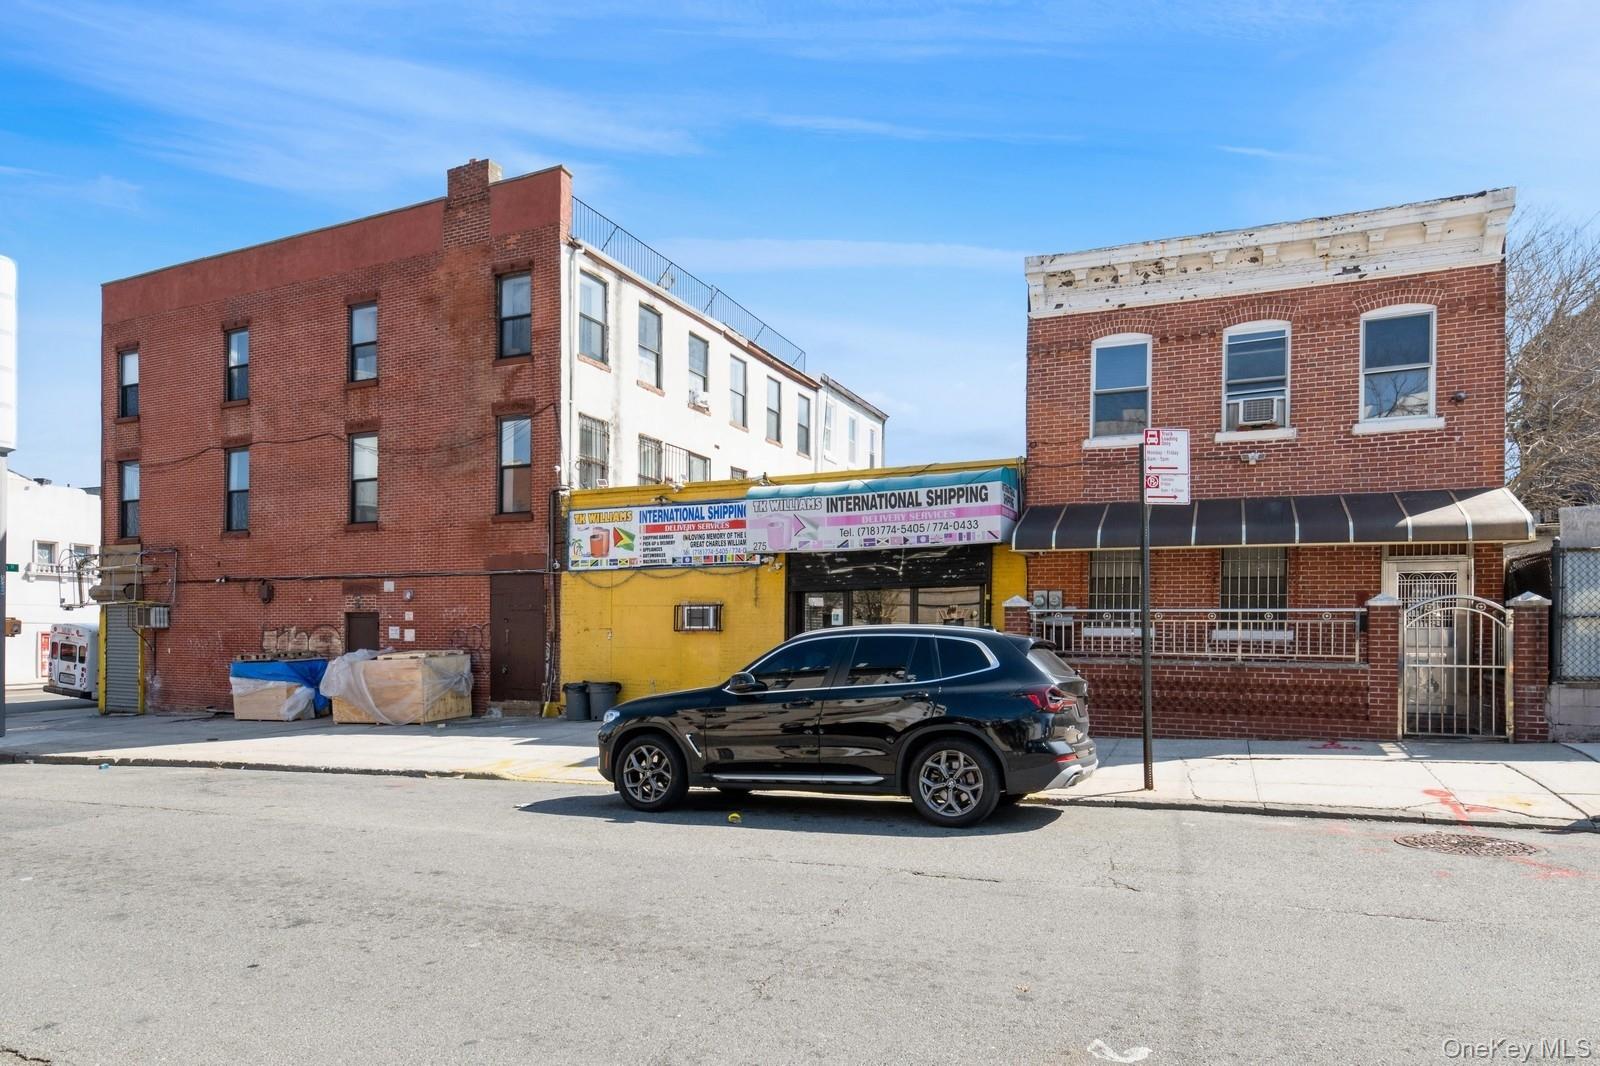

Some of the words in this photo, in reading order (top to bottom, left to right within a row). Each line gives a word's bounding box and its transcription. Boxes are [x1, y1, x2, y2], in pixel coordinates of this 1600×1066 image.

[753, 501, 768, 512] TK
[769, 498, 822, 512] WILLIAMS
[826, 491, 922, 513] INTERNATIONAL
[926, 485, 989, 507] SHIPPING
[574, 514, 586, 524] TK
[588, 511, 632, 524] WILLIAMS
[640, 506, 705, 523] INTERNATIONAL
[861, 513, 907, 524] DELIVERY
[909, 510, 956, 521] SERVICES
[665, 523, 696, 532] DELIVERY
[697, 522, 730, 530] SERVICES
[840, 528, 854, 537] Tel.
[753, 542, 767, 550] 275
